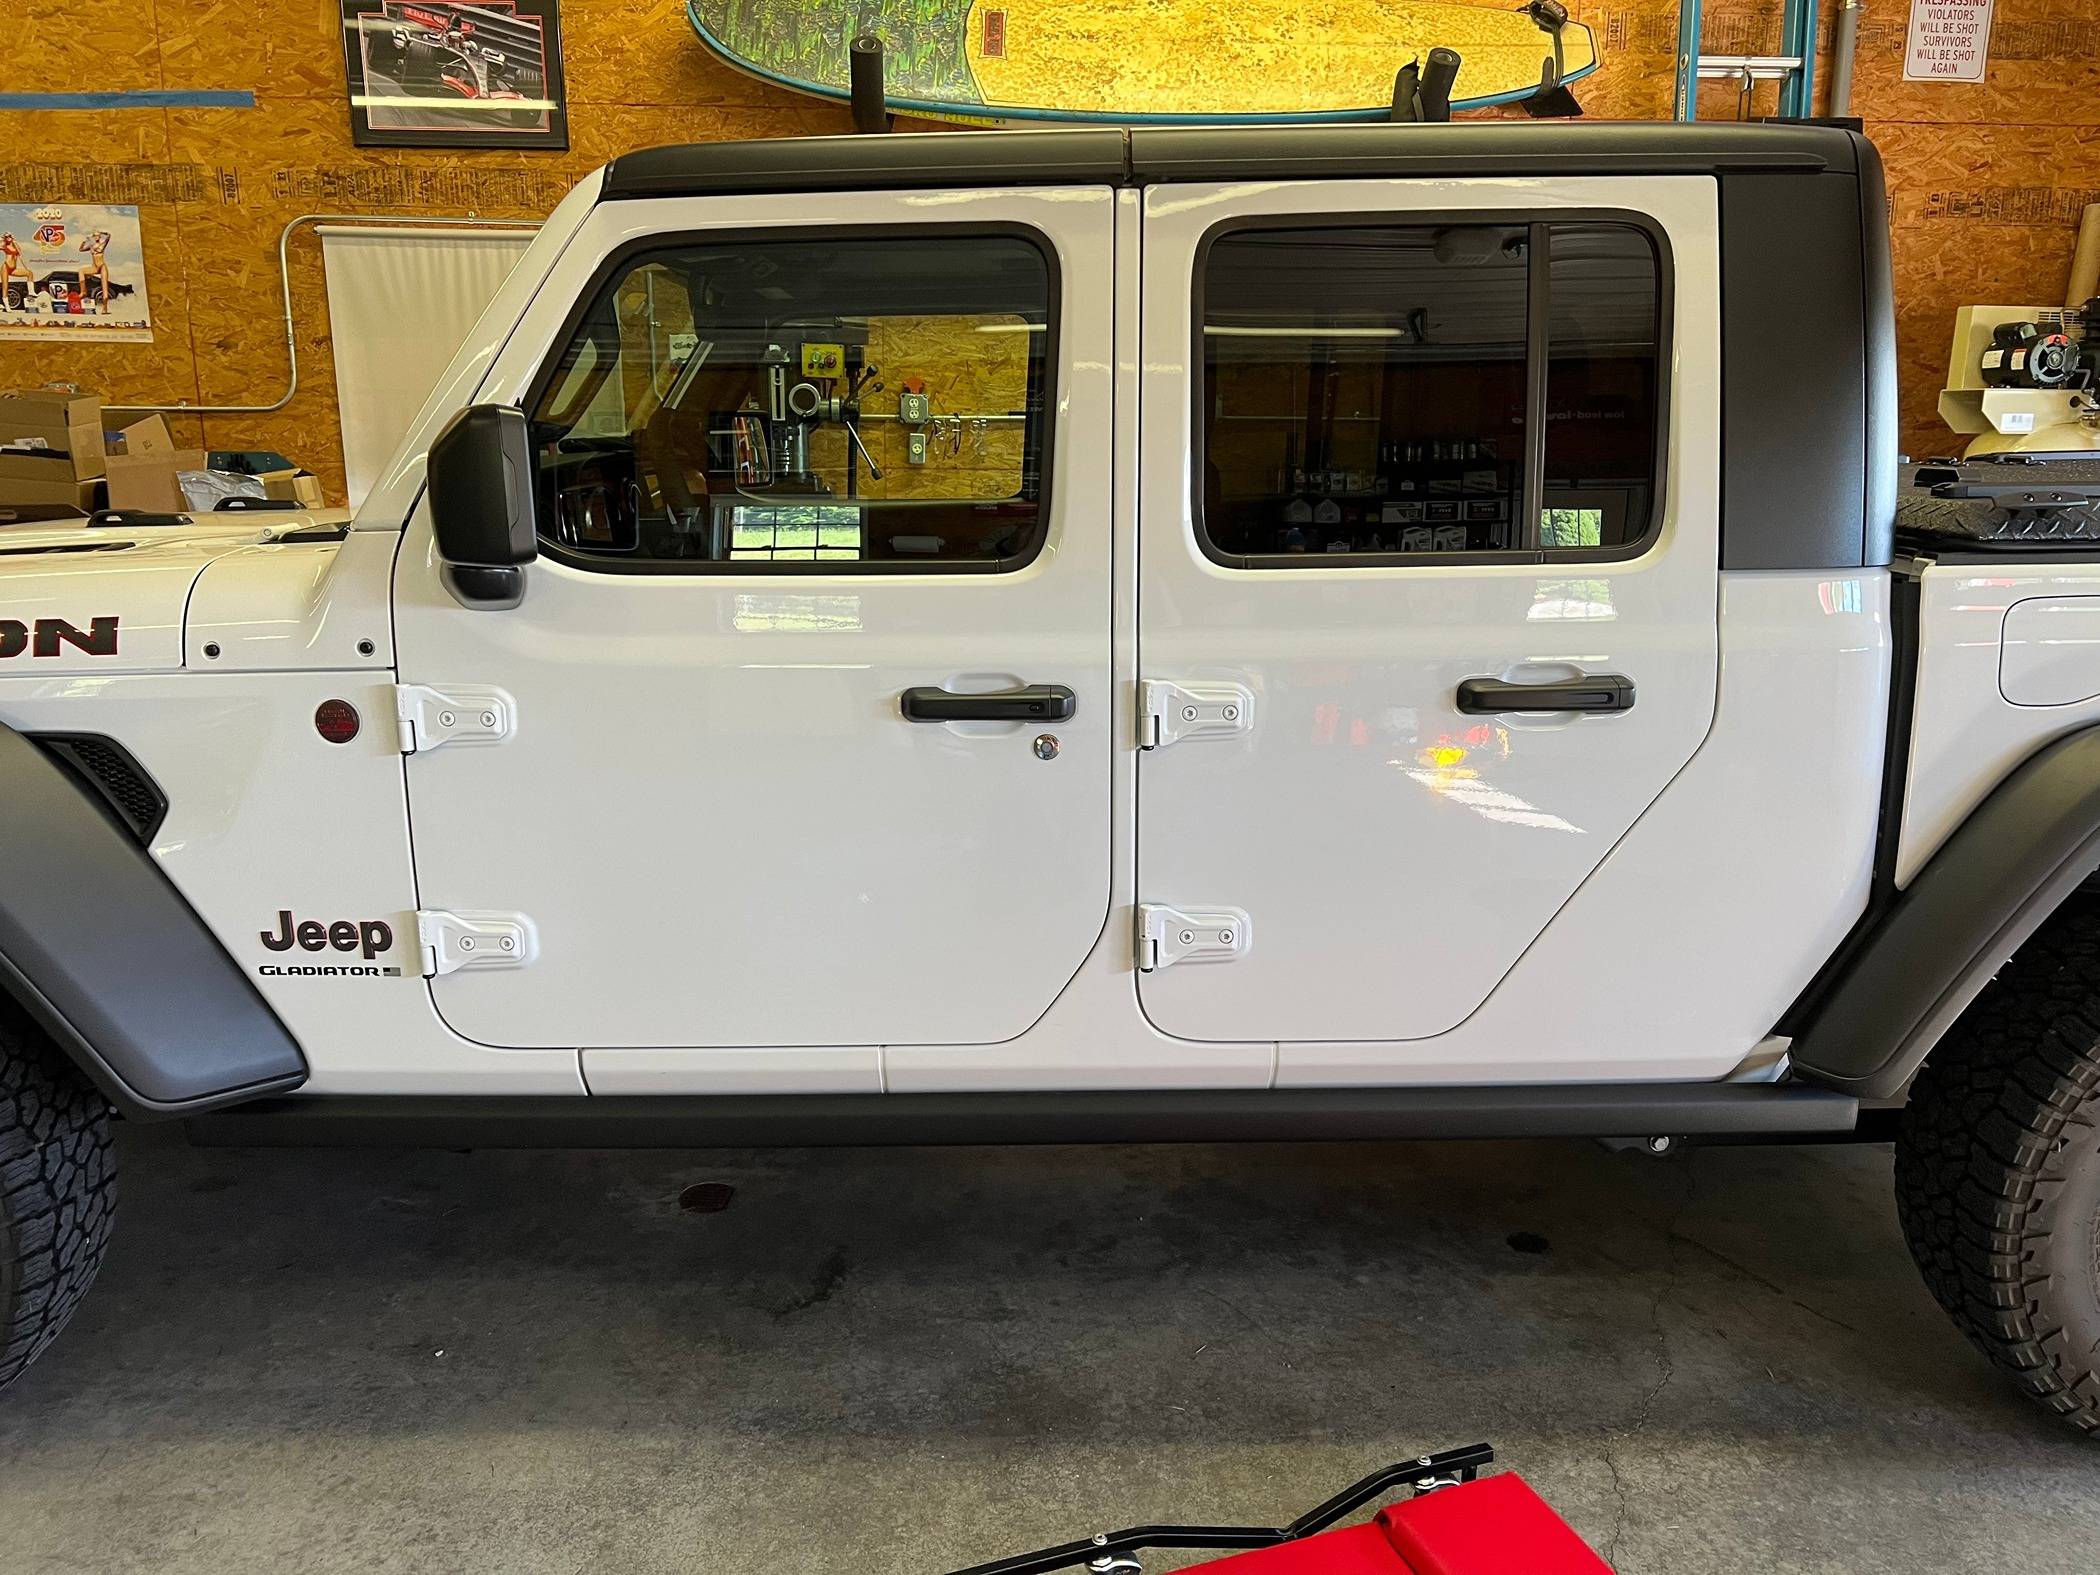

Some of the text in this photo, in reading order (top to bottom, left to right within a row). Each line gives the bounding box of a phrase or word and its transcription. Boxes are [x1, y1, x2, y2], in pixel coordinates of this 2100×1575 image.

[1927, 8, 1975, 20] VIOLATORS
[1920, 22, 1979, 34] WILL BE SHOT
[1923, 35, 1972, 48] SURVIVORS
[1916, 49, 1975, 61] WILL BE SHOT
[1930, 62, 1958, 74] AGAIN
[260, 910, 393, 960] Jeep
[258, 965, 380, 977] GLADIATOR
